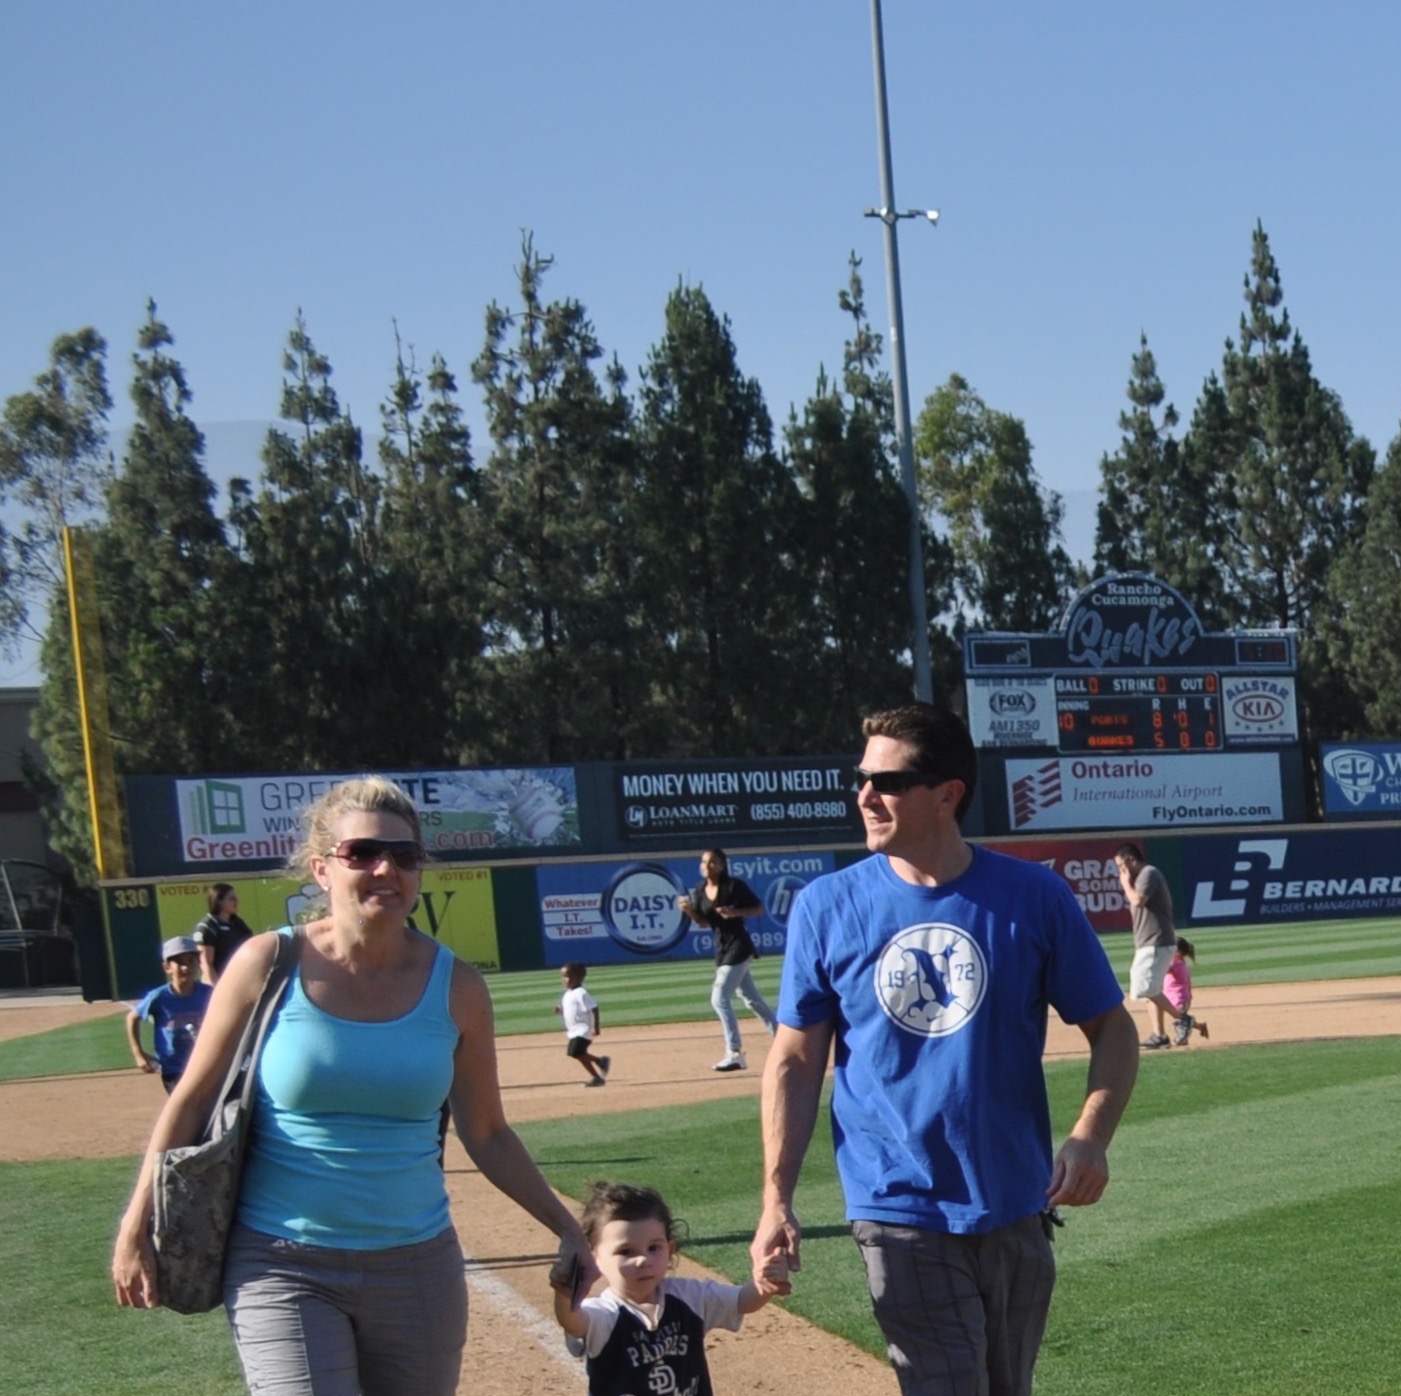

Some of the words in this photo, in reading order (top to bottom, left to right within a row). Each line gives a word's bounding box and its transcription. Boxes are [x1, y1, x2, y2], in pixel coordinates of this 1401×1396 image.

[1107, 583, 1162, 595] Rancho
[1091, 594, 1175, 609] Cucamonga
[1068, 606, 1196, 668] Quakes
[1057, 678, 1086, 692] BALL
[1113, 678, 1156, 692] STRIKE
[1180, 677, 1204, 690] OUT
[1225, 677, 1289, 700] ALLSTAR
[999, 694, 1026, 708] FOX
[1058, 701, 1090, 711] INNING
[1152, 698, 1161, 710] R
[1178, 698, 1187, 709] H
[1204, 698, 1212, 709] E
[1242, 703, 1276, 717] KIA
[1071, 760, 1153, 779] Ontario
[623, 774, 684, 797] MONEY
[688, 772, 739, 794] WHEN
[742, 771, 778, 793] YOU
[781, 770, 823, 791] NEED
[826, 768, 844, 790] IT.
[1073, 784, 1166, 801] International
[1171, 784, 1223, 800] Airport
[751, 803, 785, 821] (855)
[787, 801, 847, 819] 400-8980
[1152, 803, 1271, 822] FlyOntario.com
[438, 870, 468, 882] VOTED
[470, 870, 489, 881] #1
[115, 888, 150, 909] 330
[160, 885, 200, 897] VOTED
[544, 898, 599, 909] Whatever
[614, 894, 678, 914] DAISY
[1260, 902, 1305, 914] BUILDERS
[1313, 898, 1384, 911] MANAGEMENT
[564, 913, 584, 923] I.T.
[629, 914, 666, 931] I.T.
[556, 925, 593, 937] Takes!
[888, 969, 905, 988] 19
[955, 962, 976, 982] 72
[627, 1335, 690, 1368] PADRES
